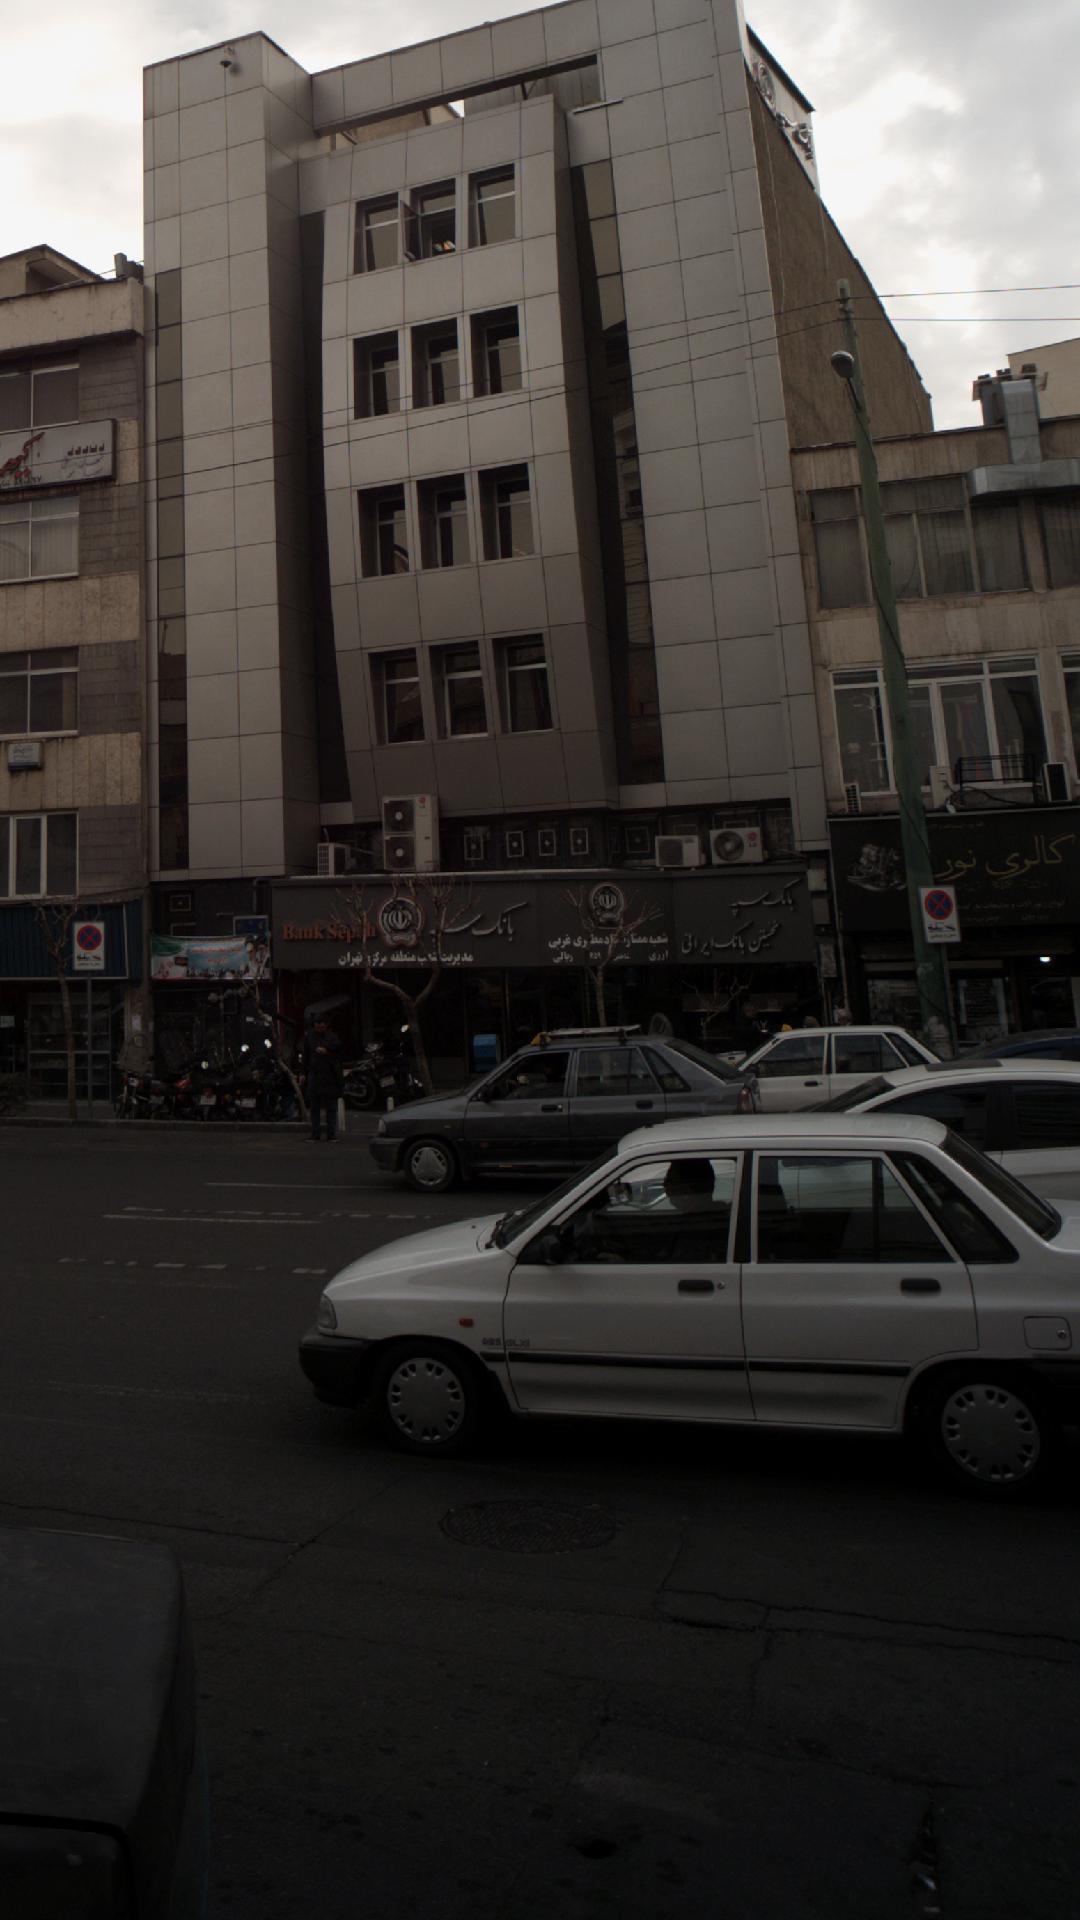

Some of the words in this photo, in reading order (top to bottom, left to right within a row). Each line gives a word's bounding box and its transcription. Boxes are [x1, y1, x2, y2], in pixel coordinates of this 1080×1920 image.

[762, 878, 801, 912] بانک
[283, 921, 323, 940] Bank
[471, 901, 528, 942] بانک
[648, 933, 669, 948] شعبه
[714, 921, 753, 956] بانک
[338, 951, 363, 967] تهران
